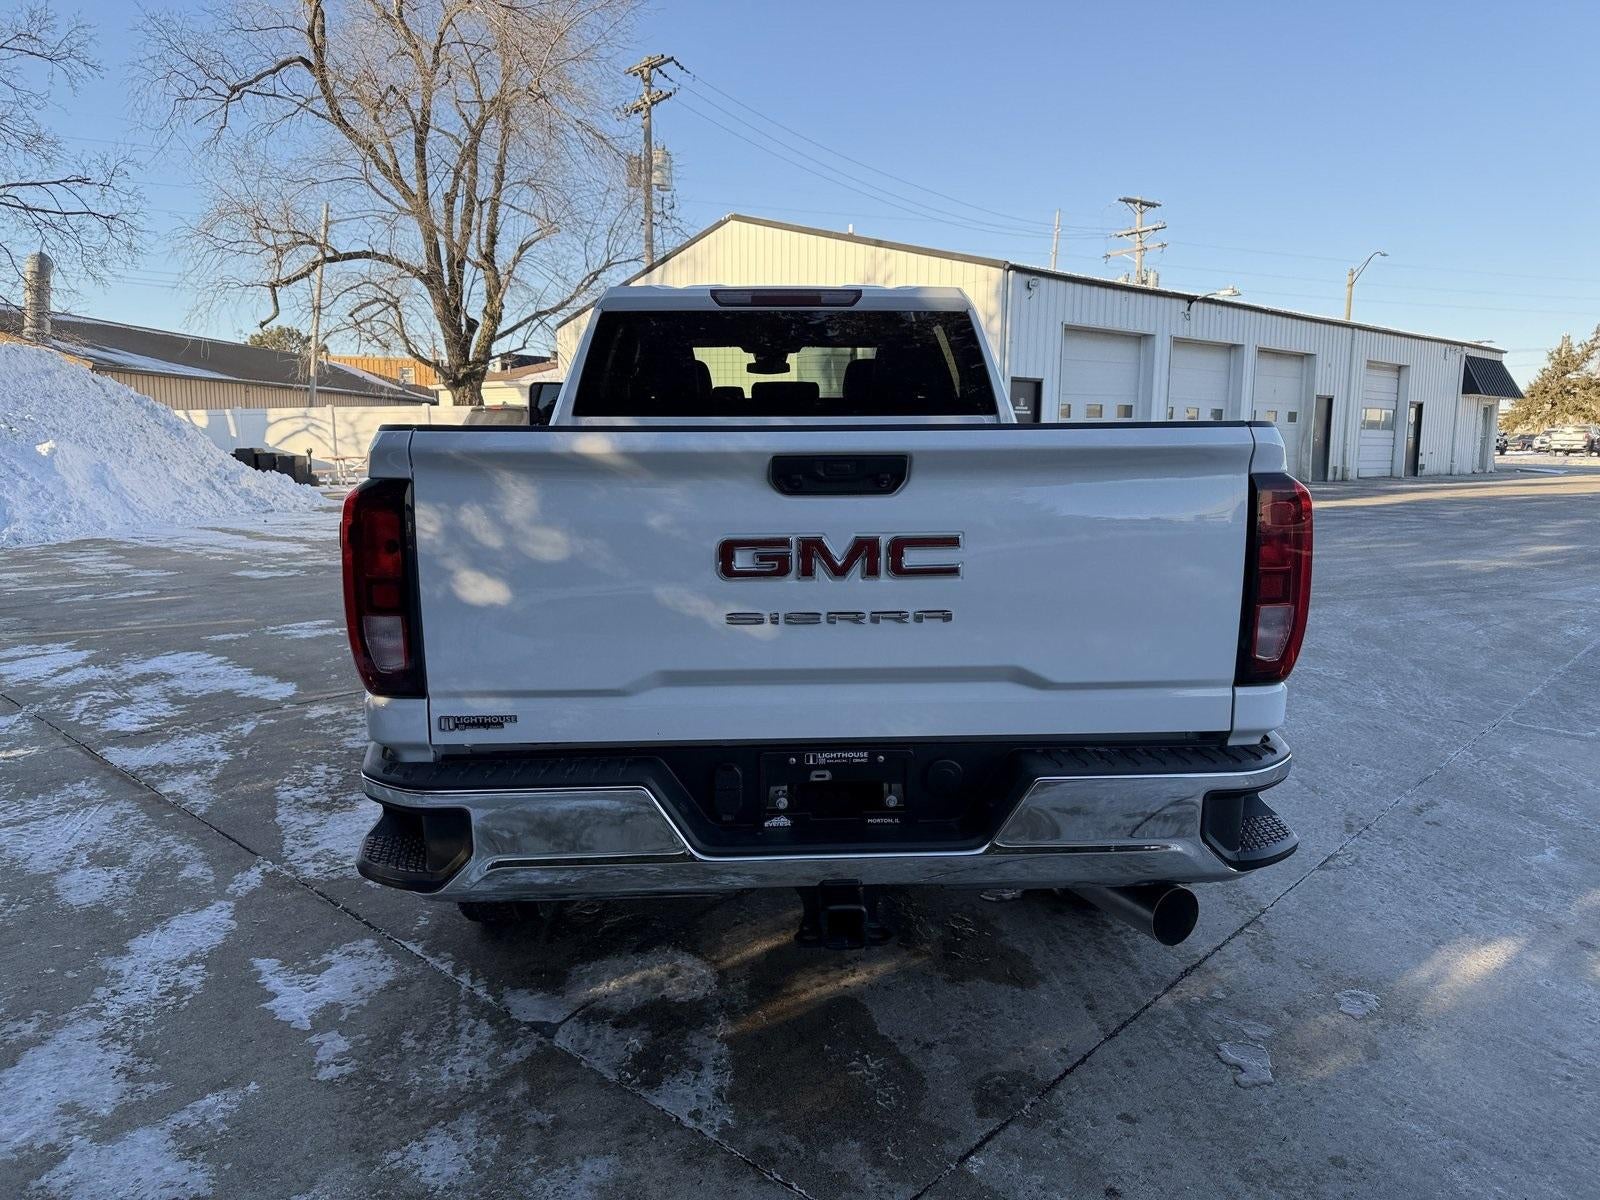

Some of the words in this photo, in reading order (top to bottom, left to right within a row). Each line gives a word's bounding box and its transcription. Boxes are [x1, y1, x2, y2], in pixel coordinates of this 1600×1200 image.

[717, 531, 964, 582] GMC
[725, 610, 953, 625] SIERRA
[455, 715, 517, 724] LIGHTHOUSE
